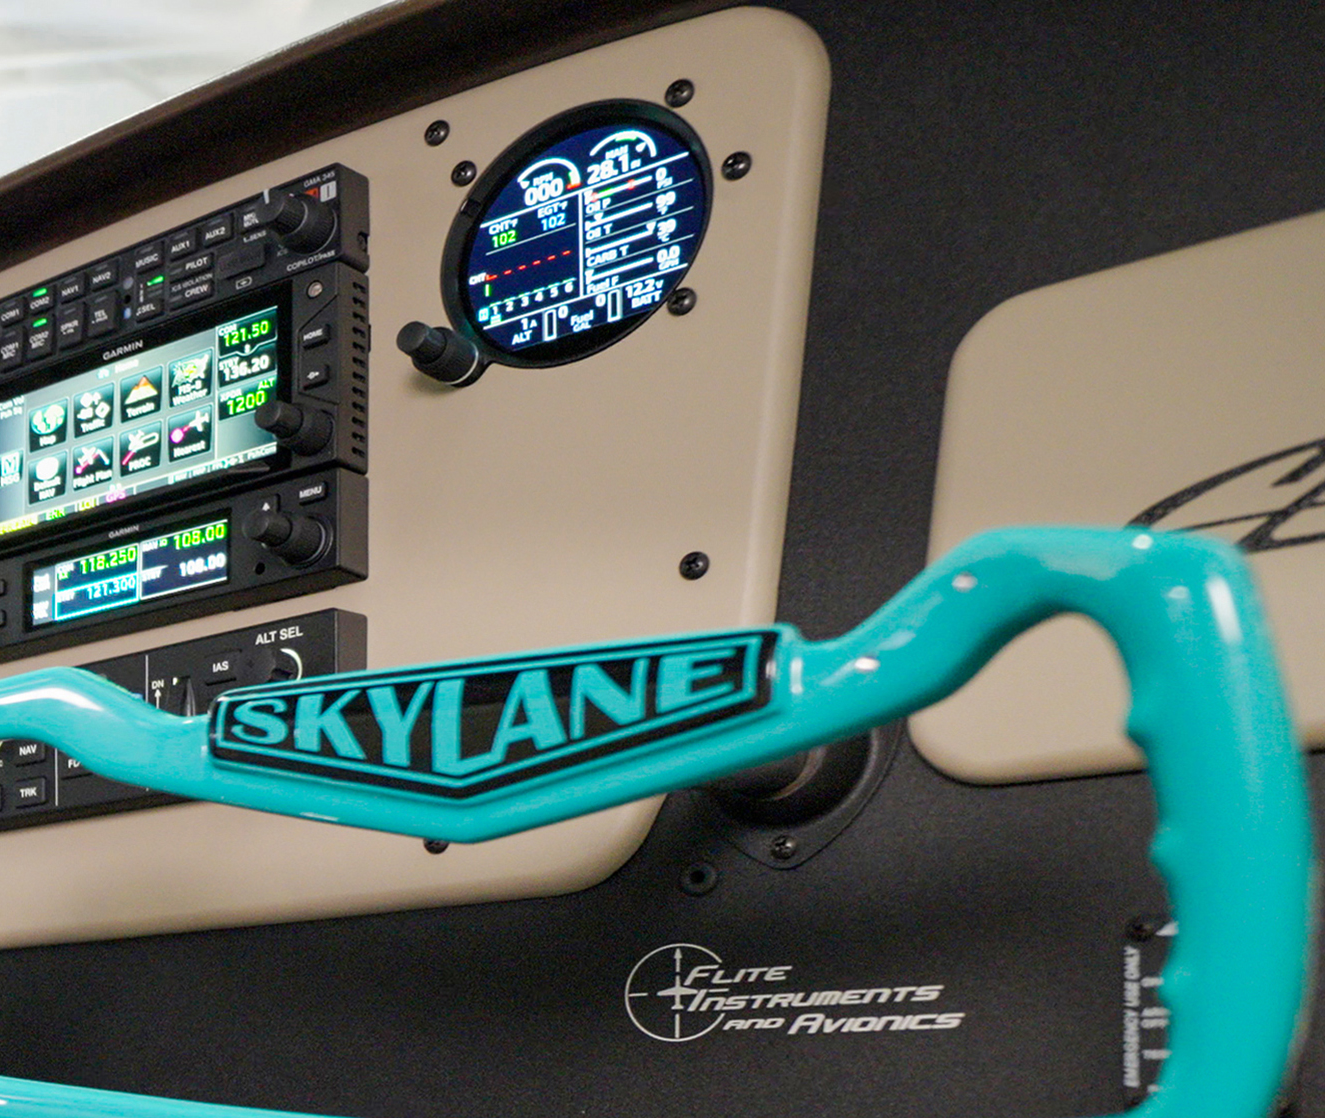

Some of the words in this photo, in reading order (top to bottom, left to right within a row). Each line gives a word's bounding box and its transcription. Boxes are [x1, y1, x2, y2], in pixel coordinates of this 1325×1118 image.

[532, 172, 554, 186] RPM
[655, 167, 667, 182] 0
[540, 212, 566, 231] 102
[205, 226, 225, 240] AUX2
[491, 230, 517, 248] 102
[171, 240, 191, 253] AUX1
[135, 252, 159, 268] MUSIC
[185, 256, 209, 271] PILOT
[585, 249, 618, 267] CARB
[92, 271, 111, 284] NAV2
[61, 285, 79, 297] NAV1
[184, 284, 209, 299] CREW
[586, 280, 609, 295] Fuel
[30, 296, 50, 310] COM2
[595, 293, 606, 307] 0
[1, 308, 20, 322] COM1
[558, 305, 568, 319] 0
[570, 310, 594, 327] Fuel
[29, 330, 49, 344] COM2
[224, 320, 269, 347] 121.50
[303, 328, 323, 341] HOME
[512, 330, 533, 345] ALT
[103, 339, 144, 361] GARMIN
[223, 355, 270, 382] 136.20
[258, 377, 275, 390] ALT
[226, 390, 266, 416] 1200
[129, 456, 152, 472] PROC
[105, 489, 127, 503] GPS
[299, 485, 323, 499] MENU
[108, 524, 140, 539] GARMIN
[173, 523, 226, 550] 108.00
[80, 547, 136, 575] 118.250
[87, 576, 136, 600] 121.300
[255, 630, 278, 646] ALT
[279, 625, 304, 640] SEL
[212, 660, 229, 672] IAS
[151, 679, 165, 689] DN
[231, 647, 739, 777] SKYLANE
[19, 744, 37, 756] NAV
[20, 787, 37, 799] TRK
[1124, 945, 1140, 980] ONLY
[1124, 980, 1140, 1008] USE
[1124, 1009, 1140, 1088] EMERGENCY
